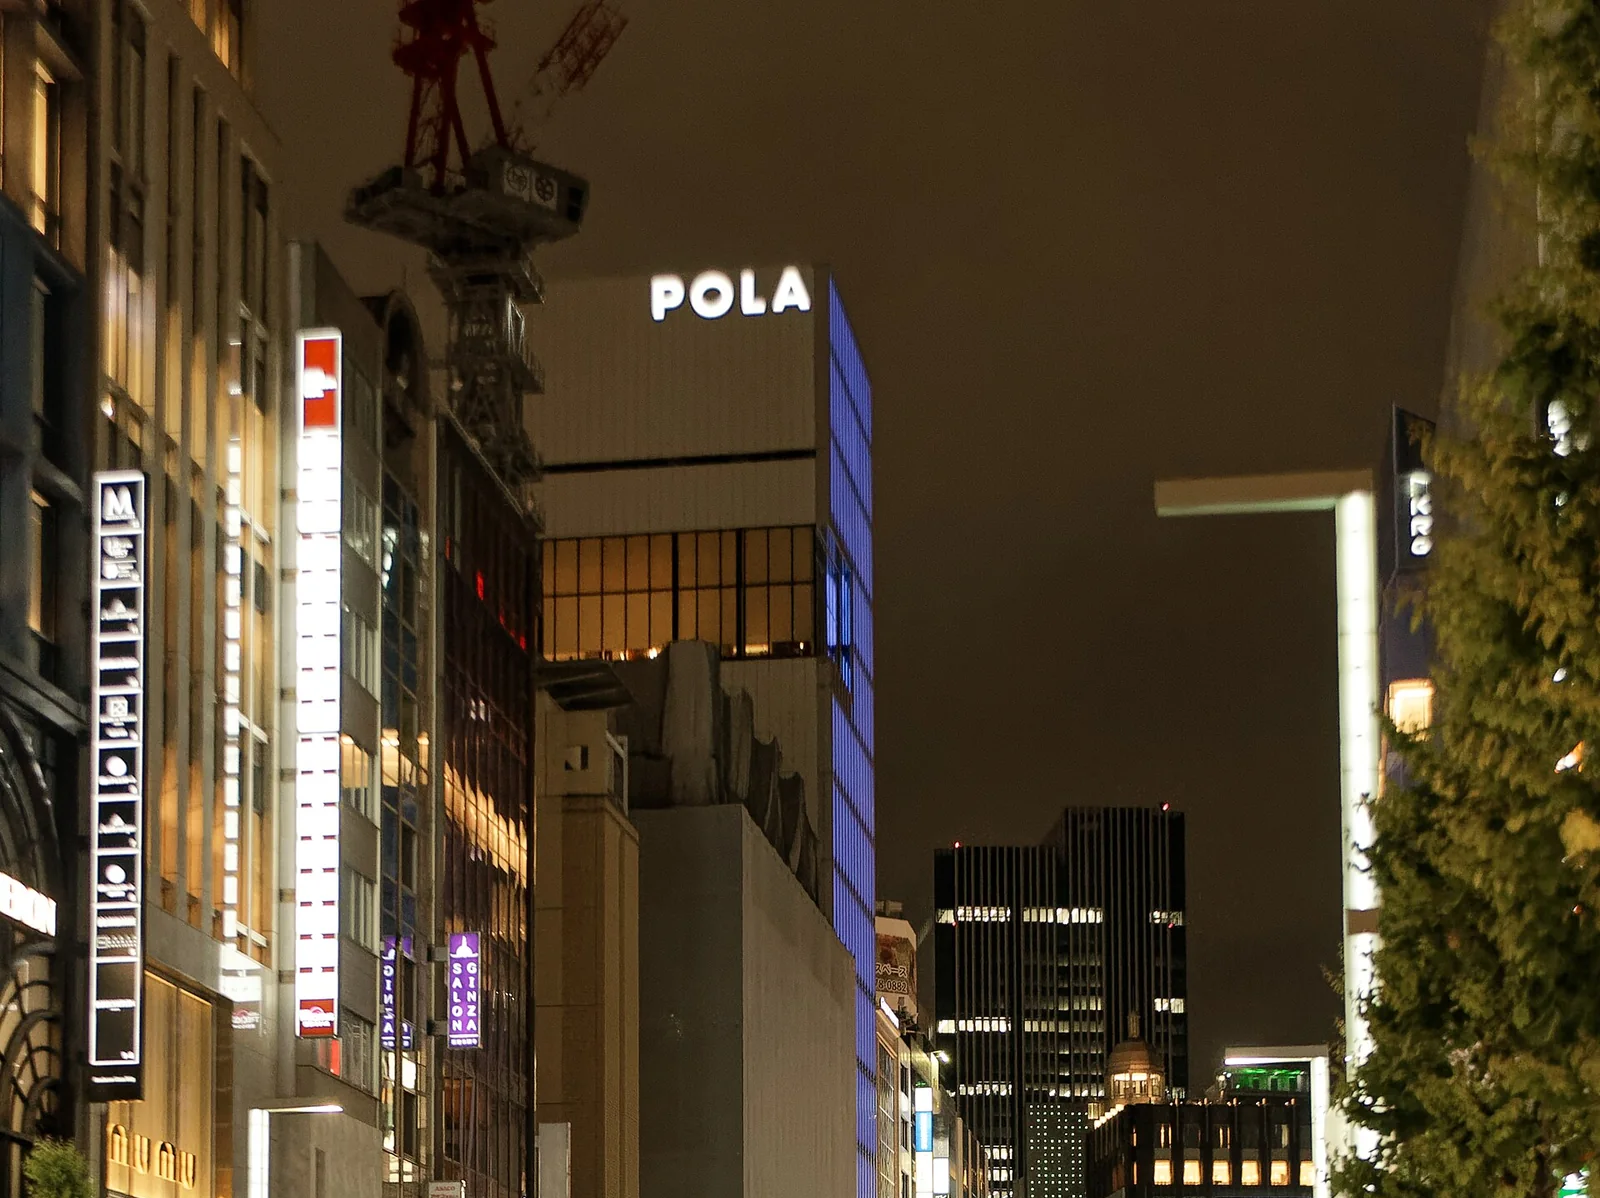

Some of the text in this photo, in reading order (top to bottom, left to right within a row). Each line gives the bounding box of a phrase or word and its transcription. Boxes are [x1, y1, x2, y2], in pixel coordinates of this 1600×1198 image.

[650, 266, 812, 321] POLA
[451, 962, 463, 1031] SALON
[466, 962, 477, 1031] GINZA
